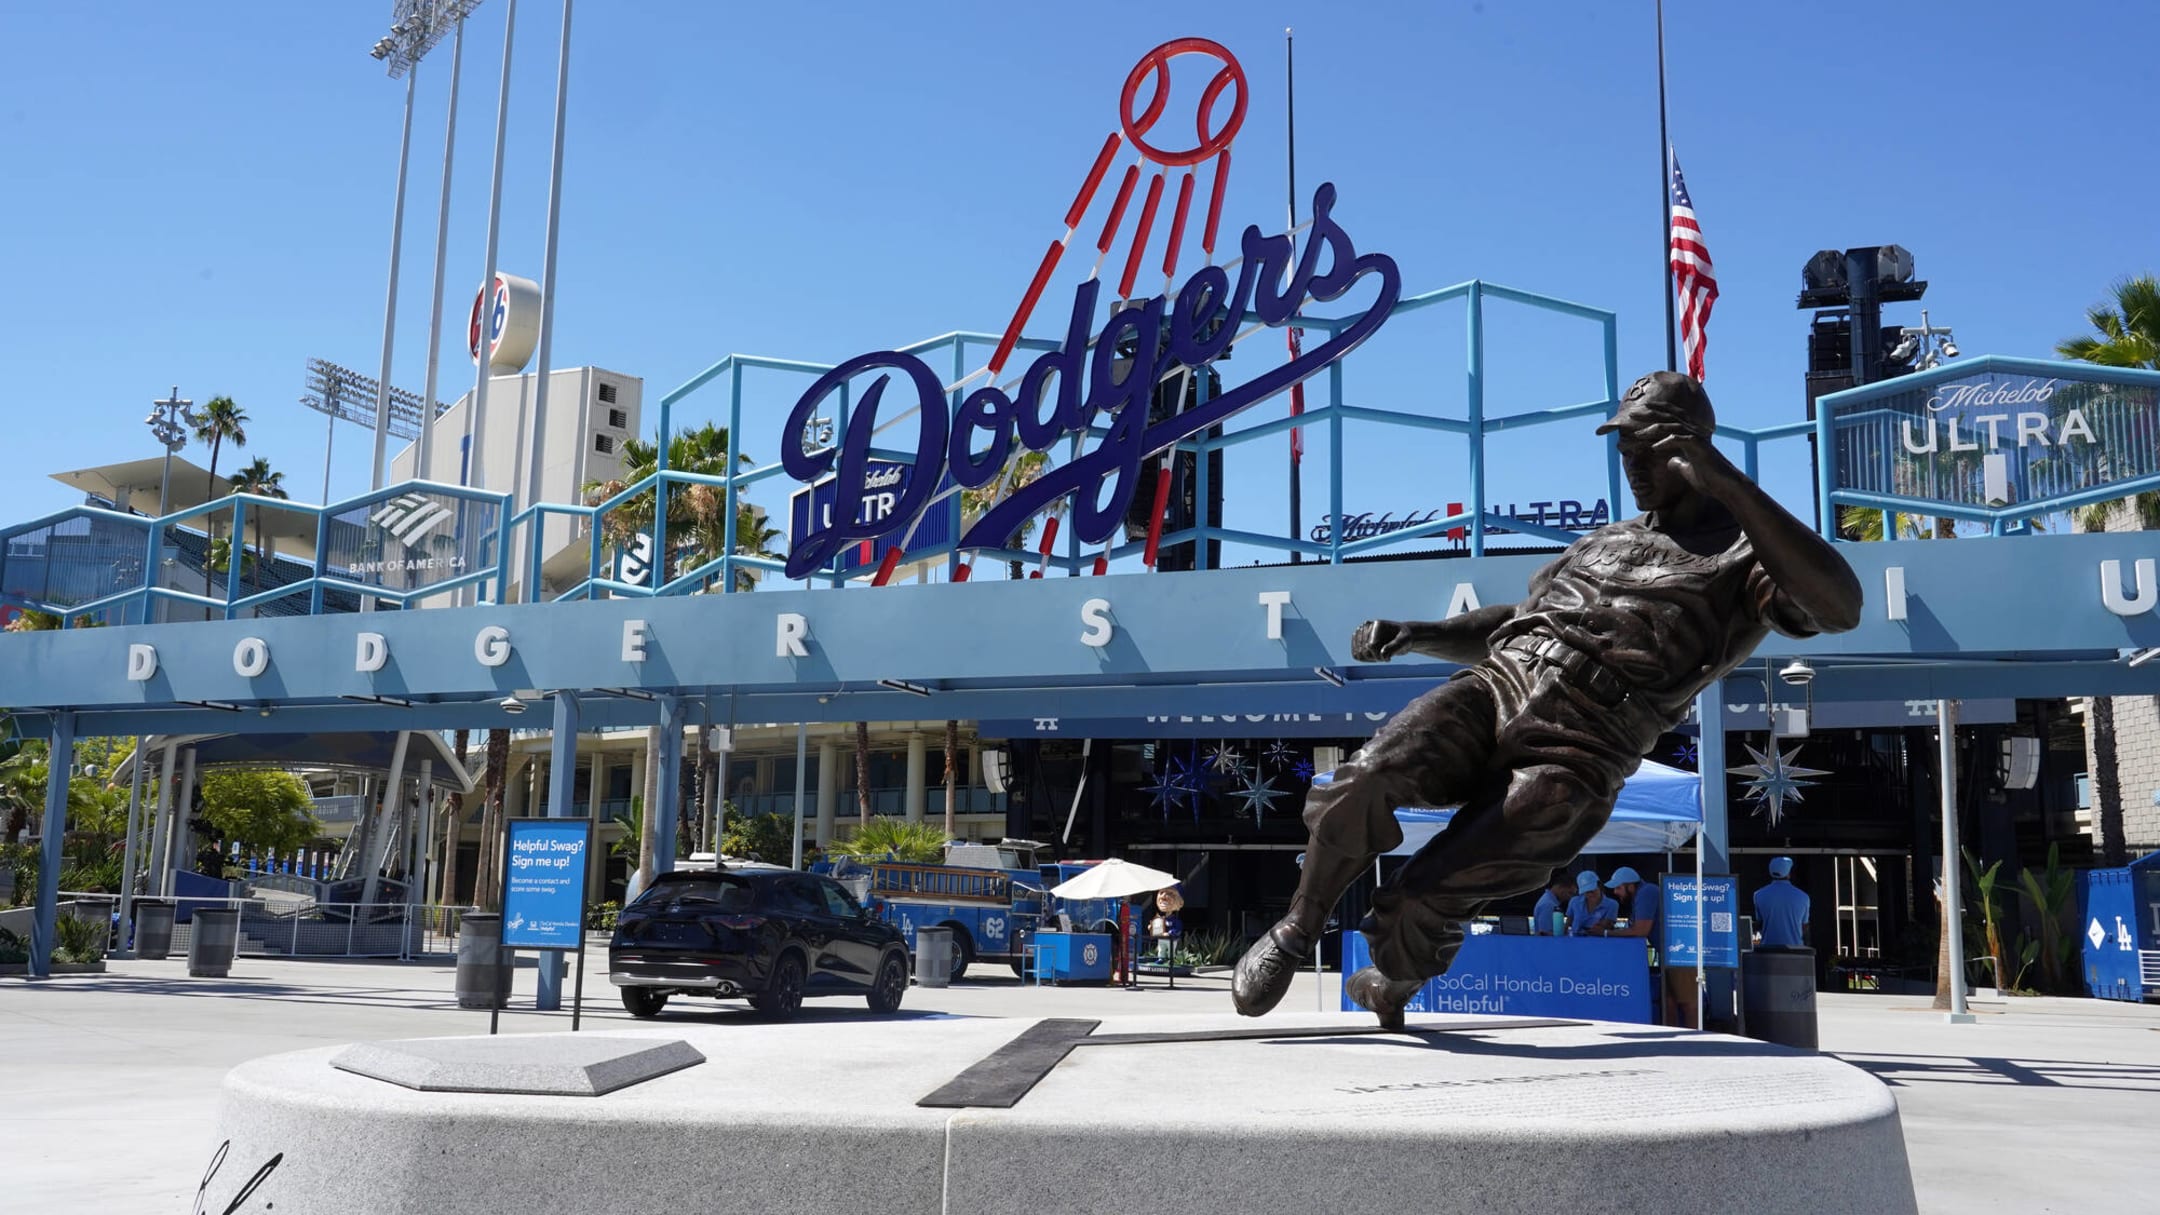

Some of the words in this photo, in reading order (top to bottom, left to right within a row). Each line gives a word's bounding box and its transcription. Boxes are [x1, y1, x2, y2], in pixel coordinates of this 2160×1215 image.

[782, 182, 1401, 580] Dodgers
[1927, 377, 2058, 411] Michelob
[1903, 409, 2096, 454] ULTRA
[349, 561, 385, 574] BANK
[387, 559, 405, 571] OF
[406, 556, 466, 571] AMERCA
[128, 613, 809, 681] DODGER
[1081, 558, 2158, 647] STAIU
[513, 840, 549, 854] Helpful
[550, 840, 583, 854] Swag?
[512, 855, 534, 869] Sign
[535, 858, 552, 866] me
[553, 856, 570, 870] up!
[1668, 882, 1697, 891] Helpfu
[1702, 883, 1730, 893] Swag?
[1673, 893, 1692, 903] Sign
[1711, 894, 1725, 903] up!
[902, 913, 913, 935] LA
[986, 917, 1005, 939] 62
[2115, 916, 2132, 951] LA
[1437, 974, 1488, 991] SoCal
[1495, 975, 1553, 993] Honda
[1559, 977, 1630, 997] Dealers
